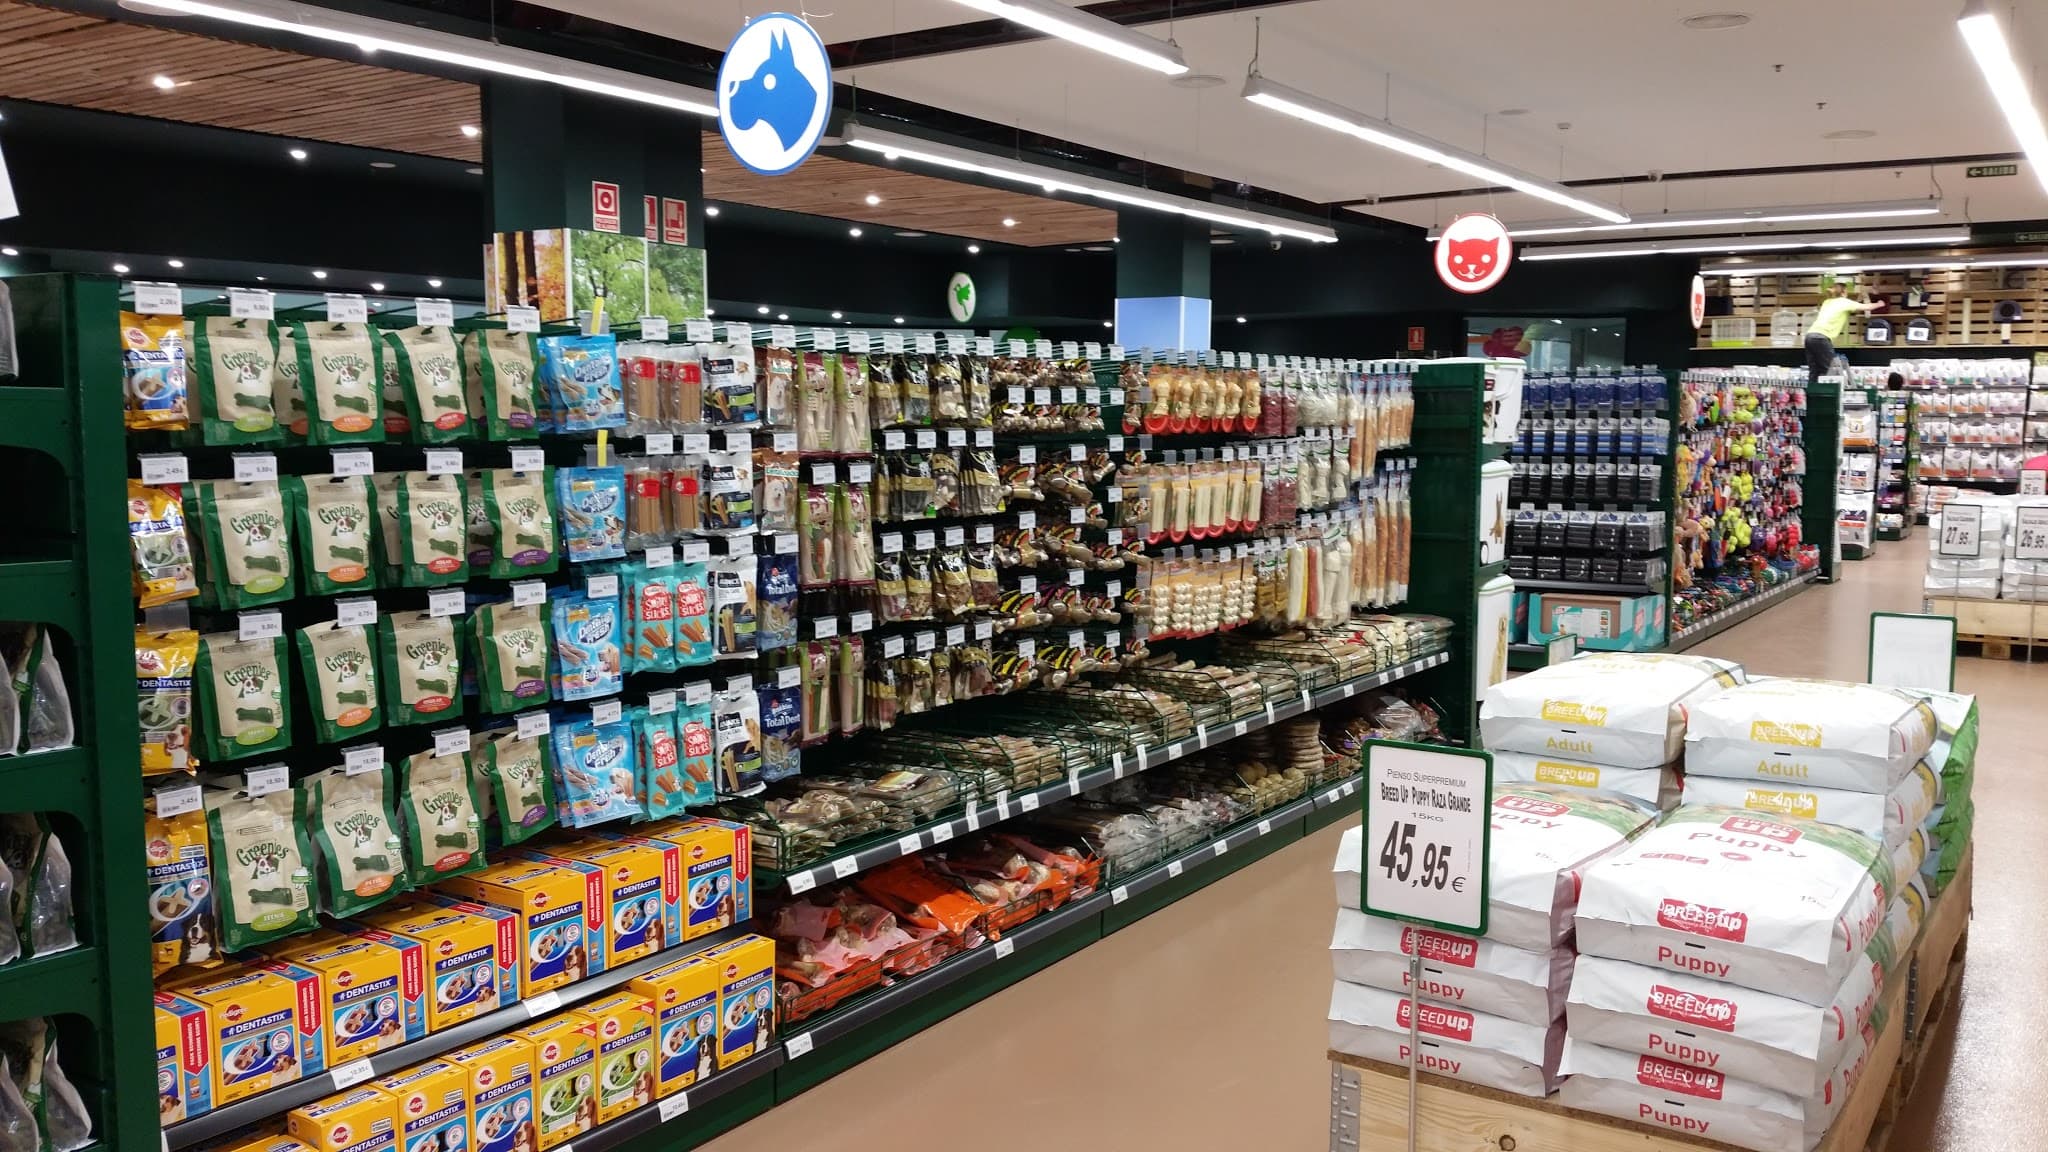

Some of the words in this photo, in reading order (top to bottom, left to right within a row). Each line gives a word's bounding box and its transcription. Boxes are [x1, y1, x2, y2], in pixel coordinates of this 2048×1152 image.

[322, 352, 370, 373] Greenies
[318, 504, 366, 525] Greenies
[417, 500, 460, 519] Greenies
[505, 495, 541, 514] Greenies
[230, 510, 281, 534] Greenies
[502, 628, 539, 648] Greenies
[324, 647, 368, 672] Greenies
[406, 638, 449, 660] Greenies
[142, 679, 191, 688] DENTASTIX
[224, 661, 272, 688] Greenies
[1546, 736, 1594, 753] Adult
[507, 756, 540, 780] Greenies
[1757, 760, 1809, 779] Adult
[422, 787, 464, 815] Greenies
[334, 810, 382, 838] Greenies
[236, 839, 289, 867] Greenies
[1379, 821, 1452, 890] 45,95
[623, 878, 658, 896] DENTASTIX
[540, 903, 579, 921] DENTASTIX
[447, 947, 489, 967] DENTASTIX
[1658, 945, 1730, 979] Puppy
[346, 979, 394, 999] DENTASTIX
[736, 971, 766, 989] DENTASTIX
[1403, 971, 1465, 1000] Puppy
[674, 997, 707, 1014] DENTASTIX
[236, 1012, 287, 1034] DENTASTIX
[612, 1029, 647, 1048] DENTASTIX
[1400, 1045, 1461, 1074] Puppy
[1648, 1033, 1720, 1067] Puppy
[552, 1053, 590, 1073] DENTASTIX
[487, 1077, 527, 1098] DENTASTIX
[418, 1104, 460, 1127] DENTASTIX
[1639, 1103, 1710, 1133] Puppy
